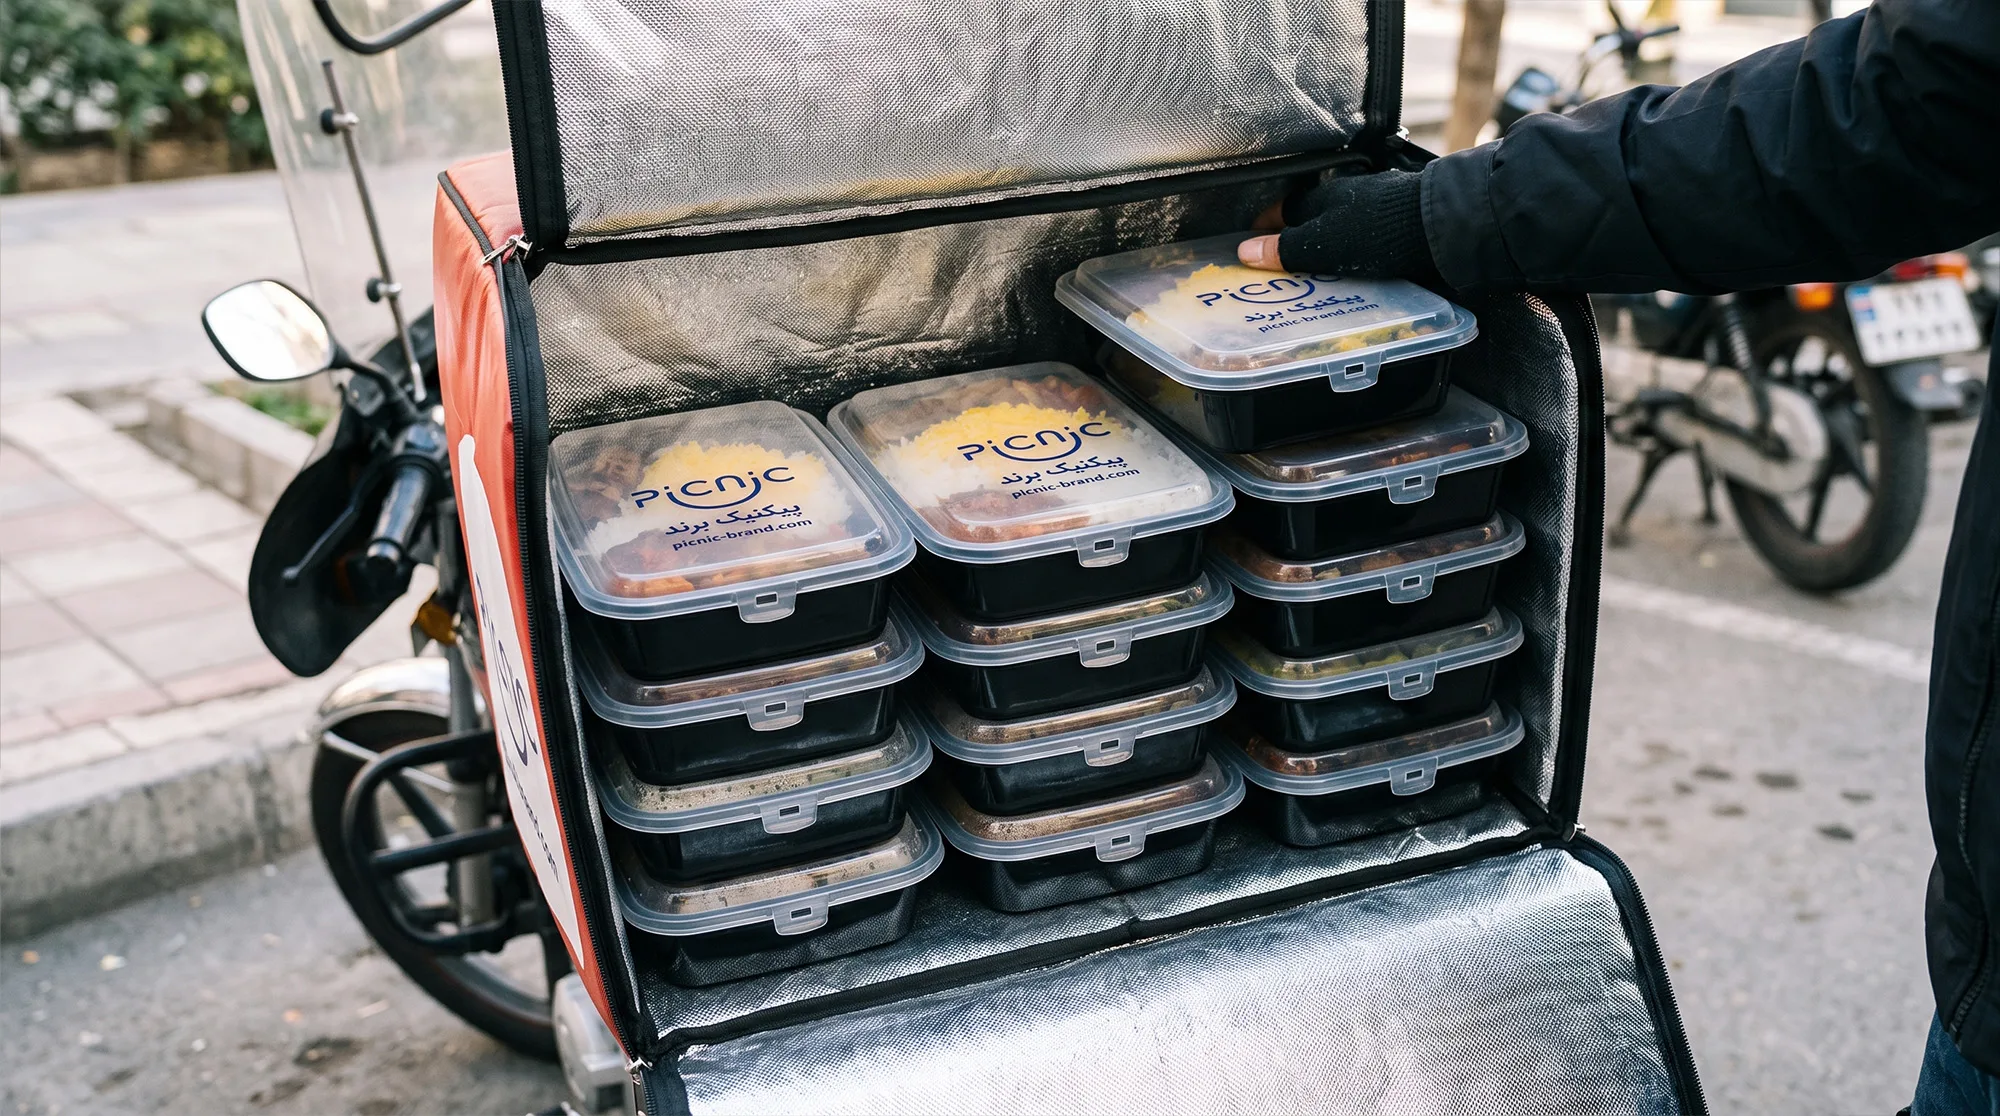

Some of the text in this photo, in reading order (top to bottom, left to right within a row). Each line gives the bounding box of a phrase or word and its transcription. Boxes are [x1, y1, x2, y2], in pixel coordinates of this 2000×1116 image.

[1244, 310, 1283, 323] برند
[1001, 471, 1041, 485] برند
[1011, 467, 1141, 500] picnic-brand.com
[664, 519, 710, 536] برند
[672, 518, 813, 552] picnic-brand.com
